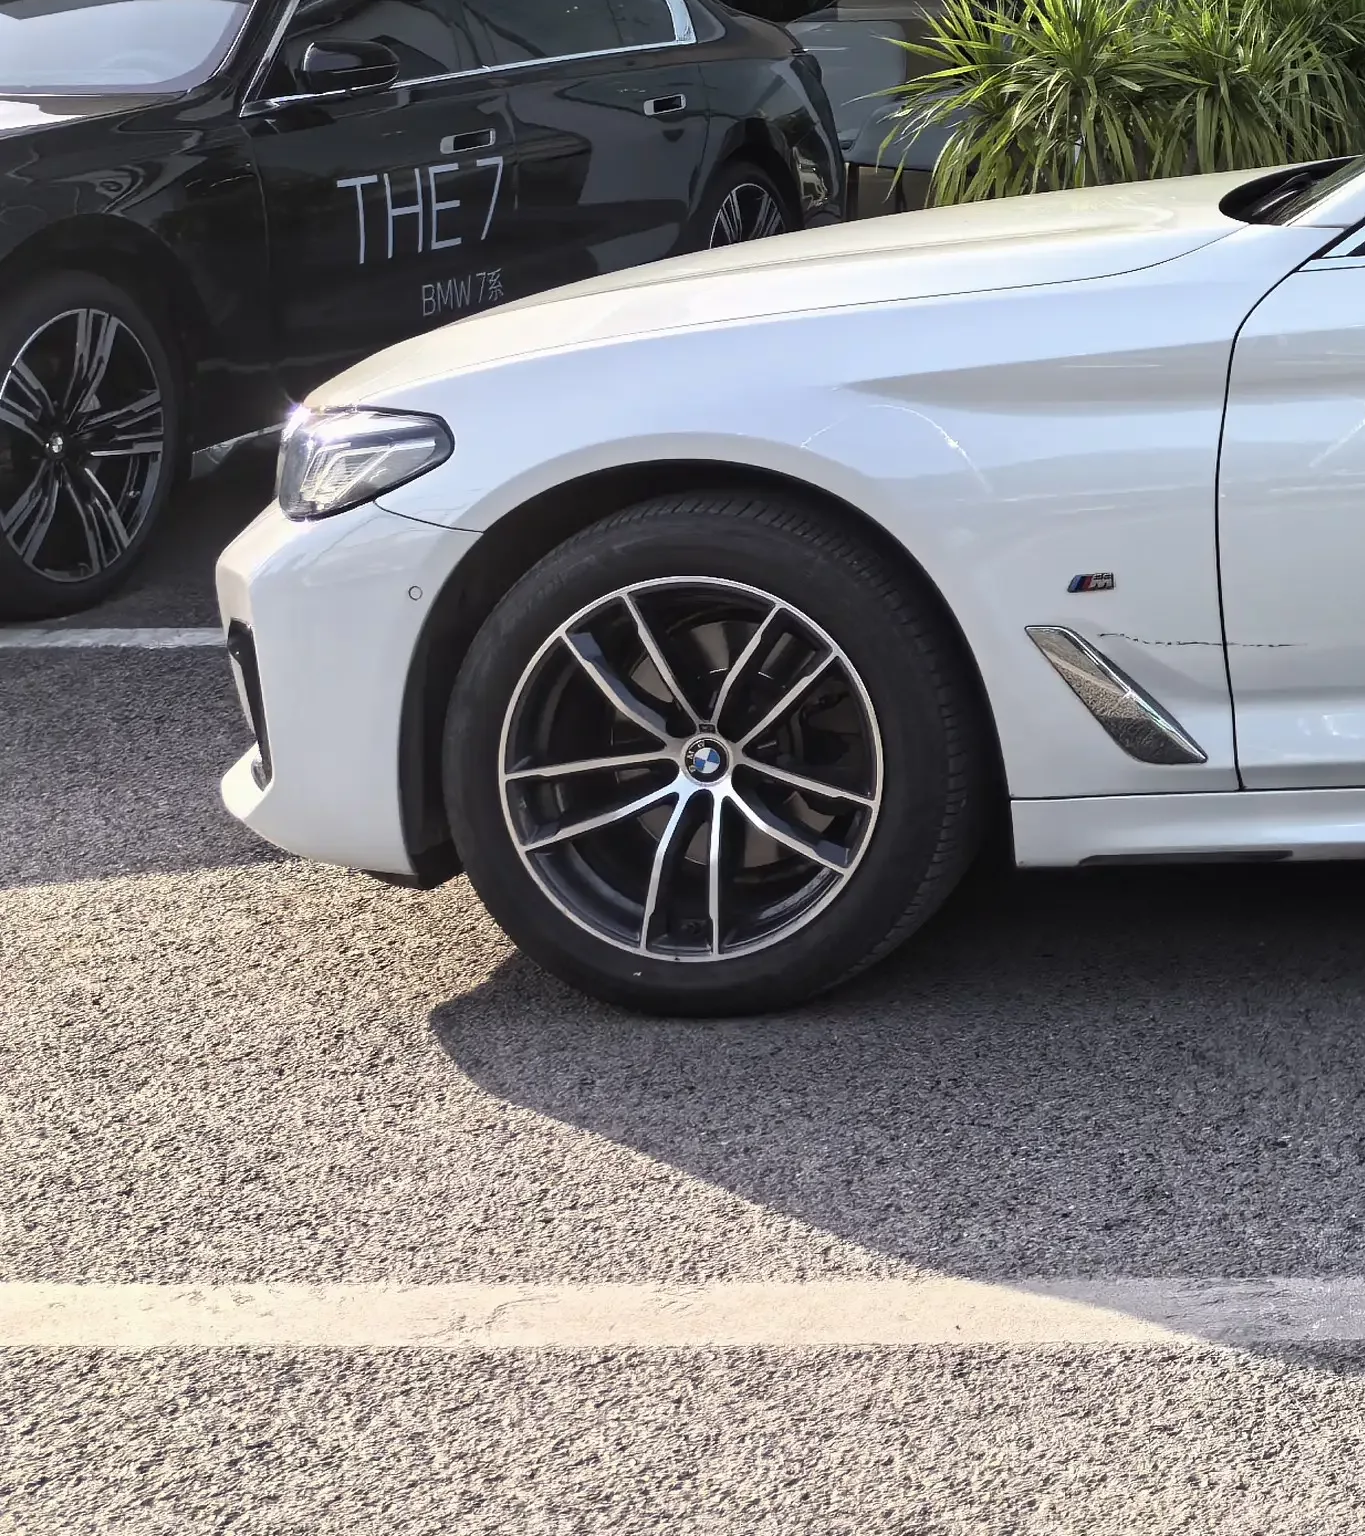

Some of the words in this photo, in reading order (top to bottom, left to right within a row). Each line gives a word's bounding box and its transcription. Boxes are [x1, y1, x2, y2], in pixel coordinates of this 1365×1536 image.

[337, 163, 462, 264] THE
[476, 156, 503, 240] 7
[422, 275, 471, 316] BMW
[476, 268, 504, 306] 7系
